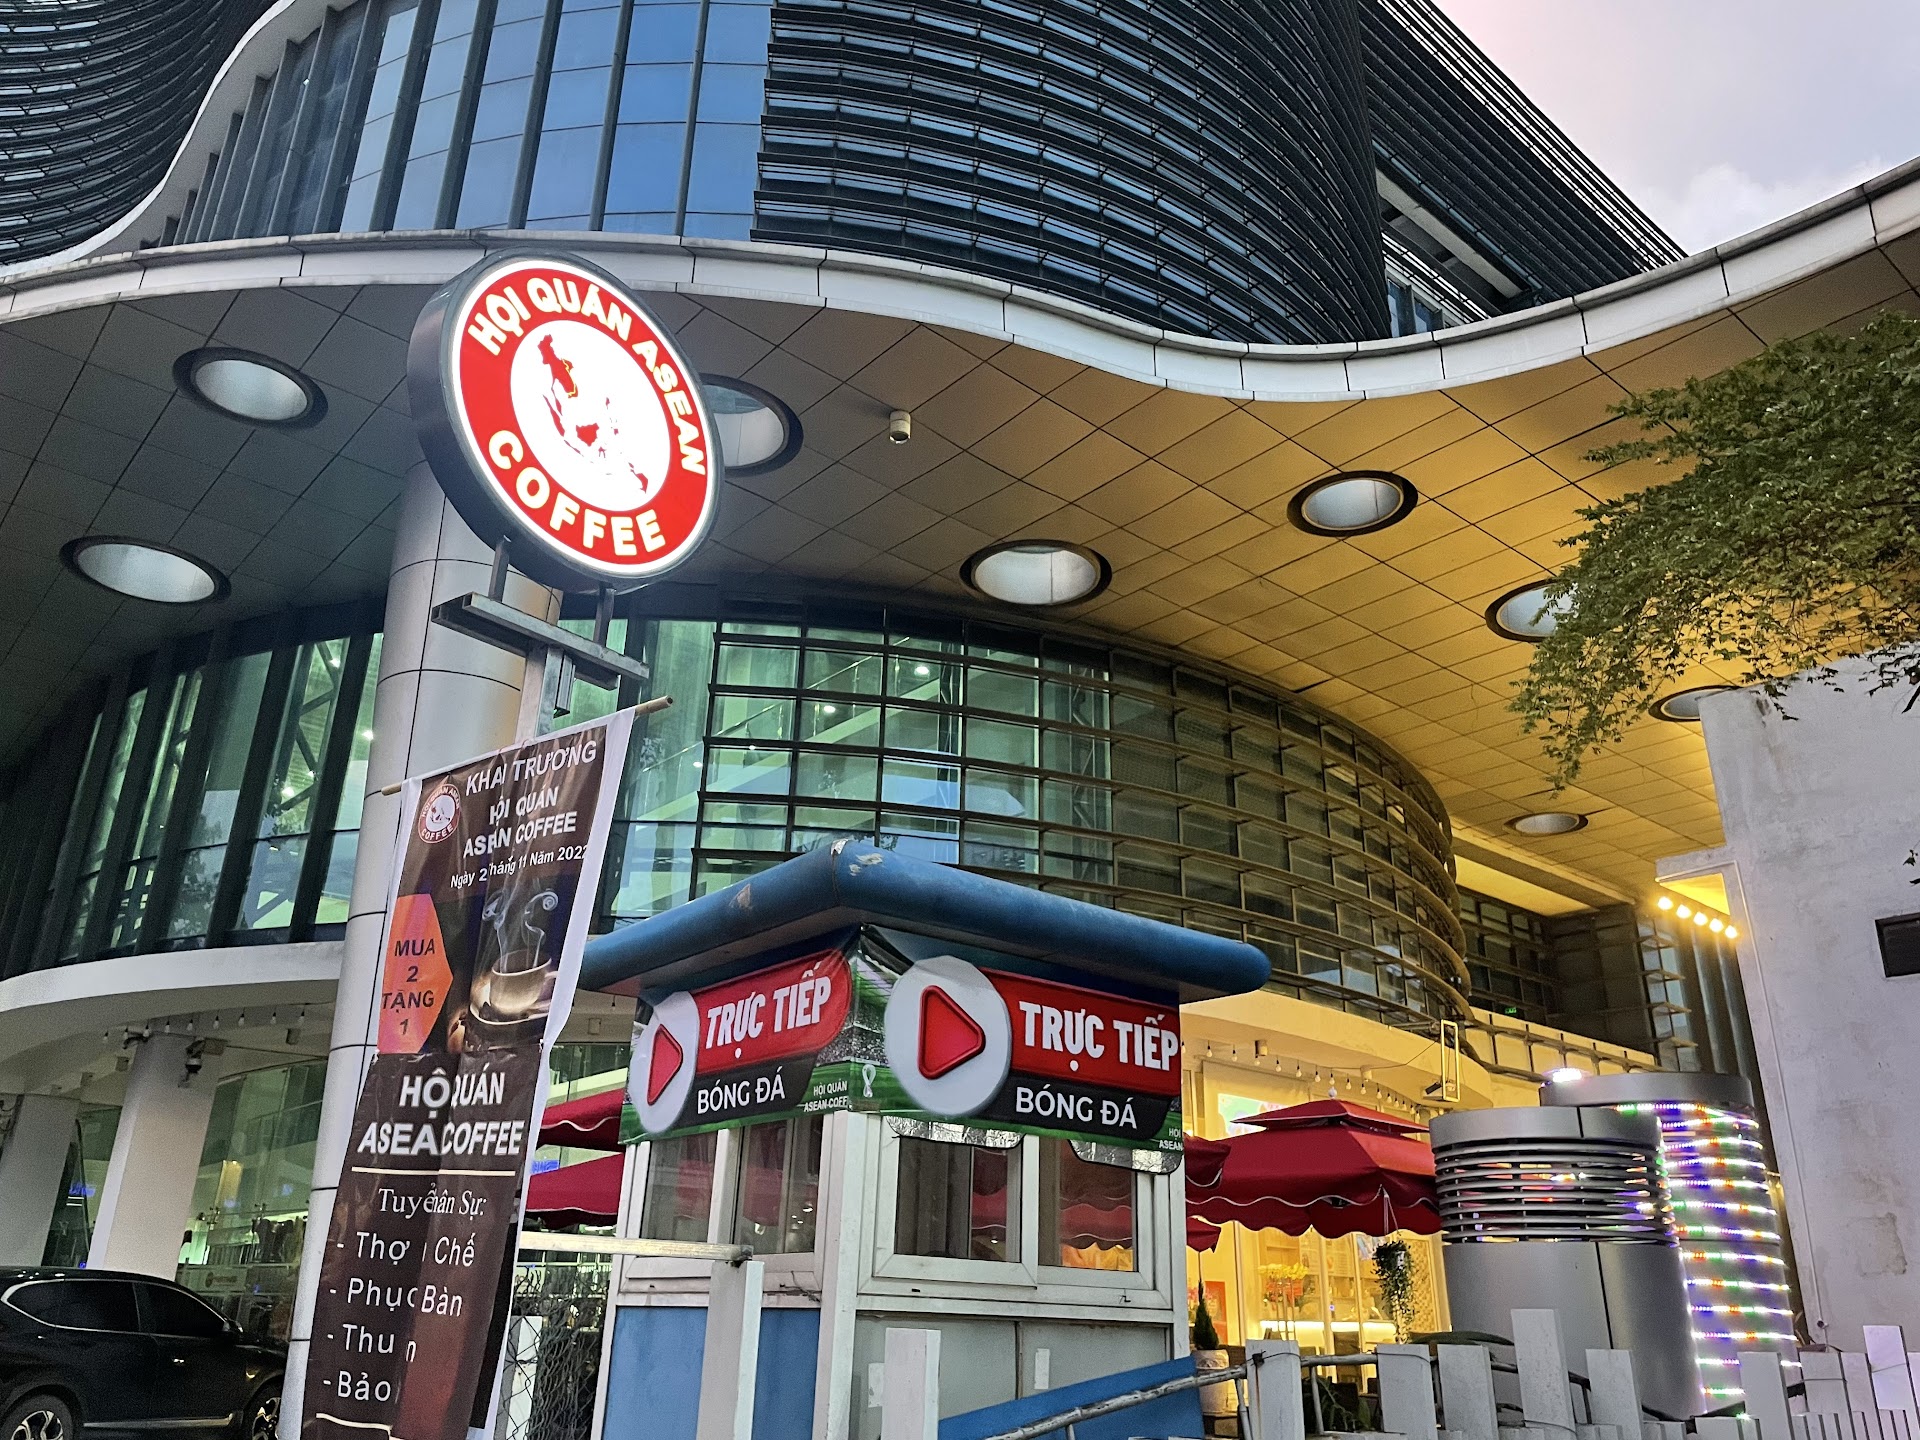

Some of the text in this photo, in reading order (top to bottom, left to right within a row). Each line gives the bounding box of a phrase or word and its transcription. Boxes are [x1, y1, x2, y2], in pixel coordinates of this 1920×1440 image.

[526, 277, 632, 341] QUÁN
[632, 340, 706, 475] ASEAN
[488, 429, 666, 556] COFFEE
[465, 740, 597, 797] KHAI TRƯƠNG
[515, 783, 559, 817] QUÁN
[421, 822, 455, 841] COFFEE
[515, 811, 578, 845] COFFEE
[450, 870, 476, 890] Ngày
[529, 850, 554, 866] Năm
[394, 938, 435, 957] MUA
[406, 965, 419, 983] 2
[399, 1018, 409, 1036] 1
[705, 961, 832, 1059] TRỰC TIẾP
[1018, 1000, 1179, 1072] TRỰC TIẾP
[697, 1066, 786, 1115] BÓNG ĐÁ
[826, 1078, 848, 1094] QUÁN
[803, 1099, 828, 1112] ASEAN
[1016, 1083, 1138, 1129] BÓNG ĐÁ
[440, 1120, 526, 1156] COFFEE
[1159, 1139, 1184, 1152] ASEAN
[356, 1231, 411, 1266] Thợ
[434, 1232, 476, 1268] Chế
[421, 1284, 463, 1317] Bàn
[342, 1323, 395, 1354] Thu
[337, 1370, 392, 1402] Bảo
